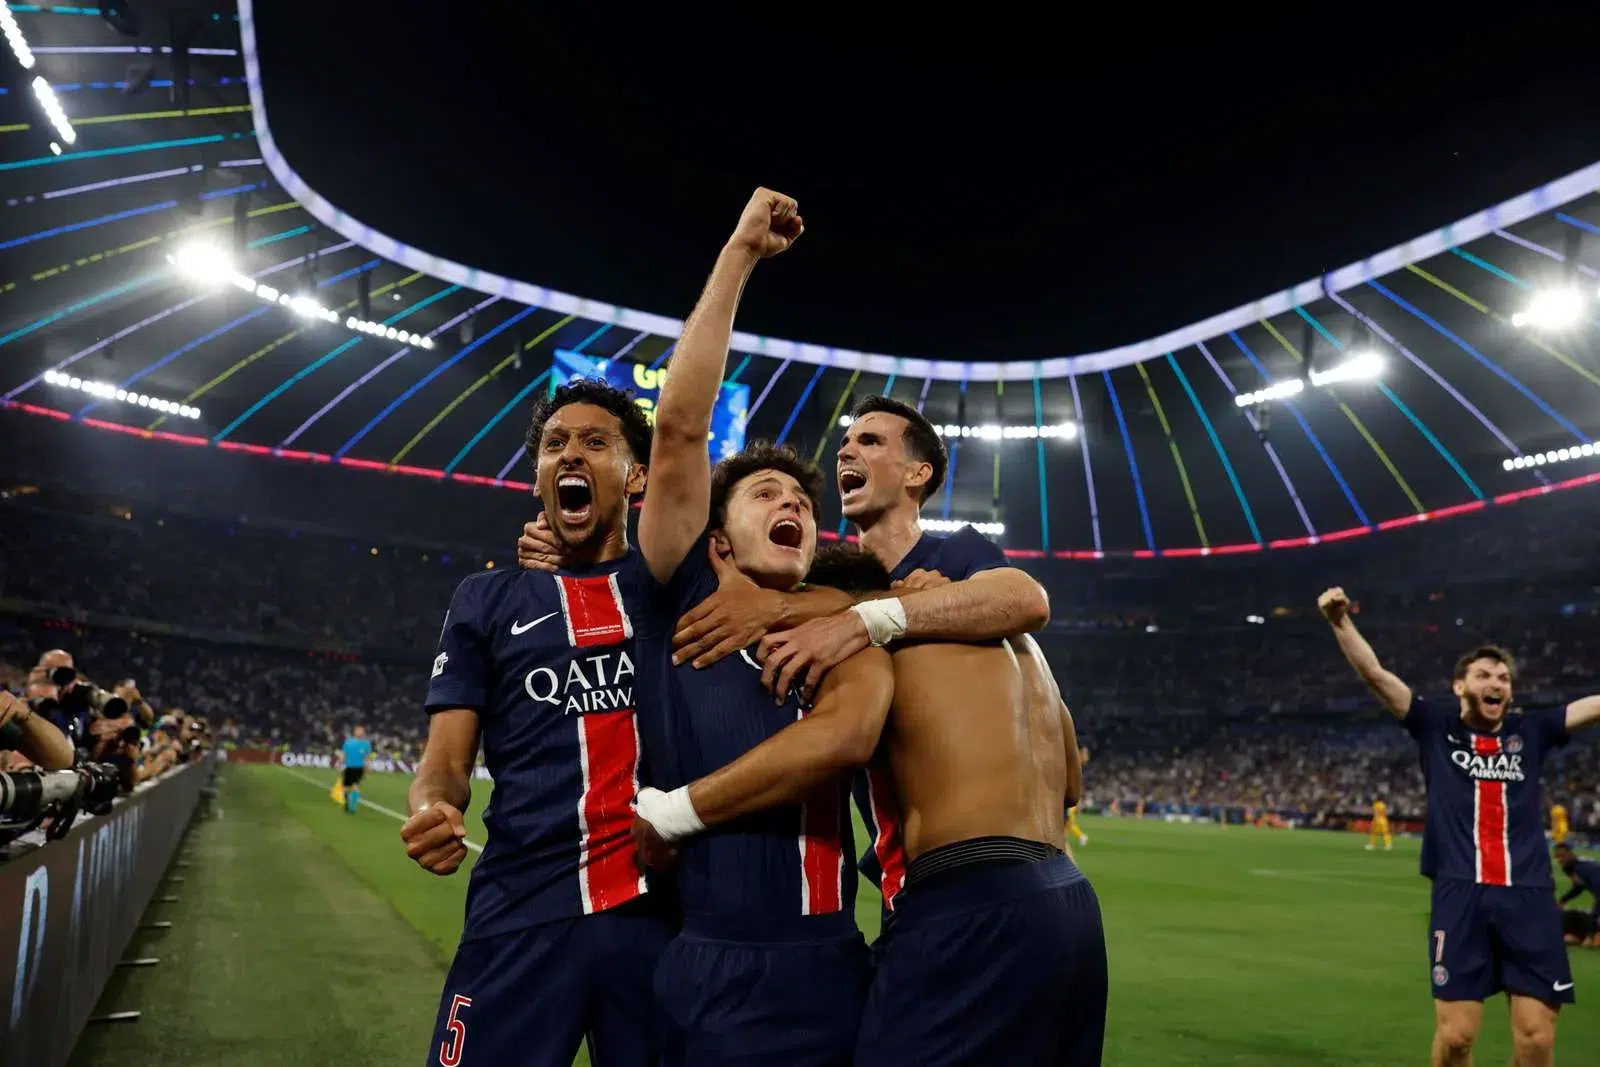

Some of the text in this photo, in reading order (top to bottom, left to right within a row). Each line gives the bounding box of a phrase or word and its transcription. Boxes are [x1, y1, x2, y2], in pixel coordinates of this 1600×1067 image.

[524, 651, 635, 706] QATA
[564, 686, 636, 715] AIRW
[1451, 750, 1522, 771] QATAR
[439, 994, 472, 1067] 5
